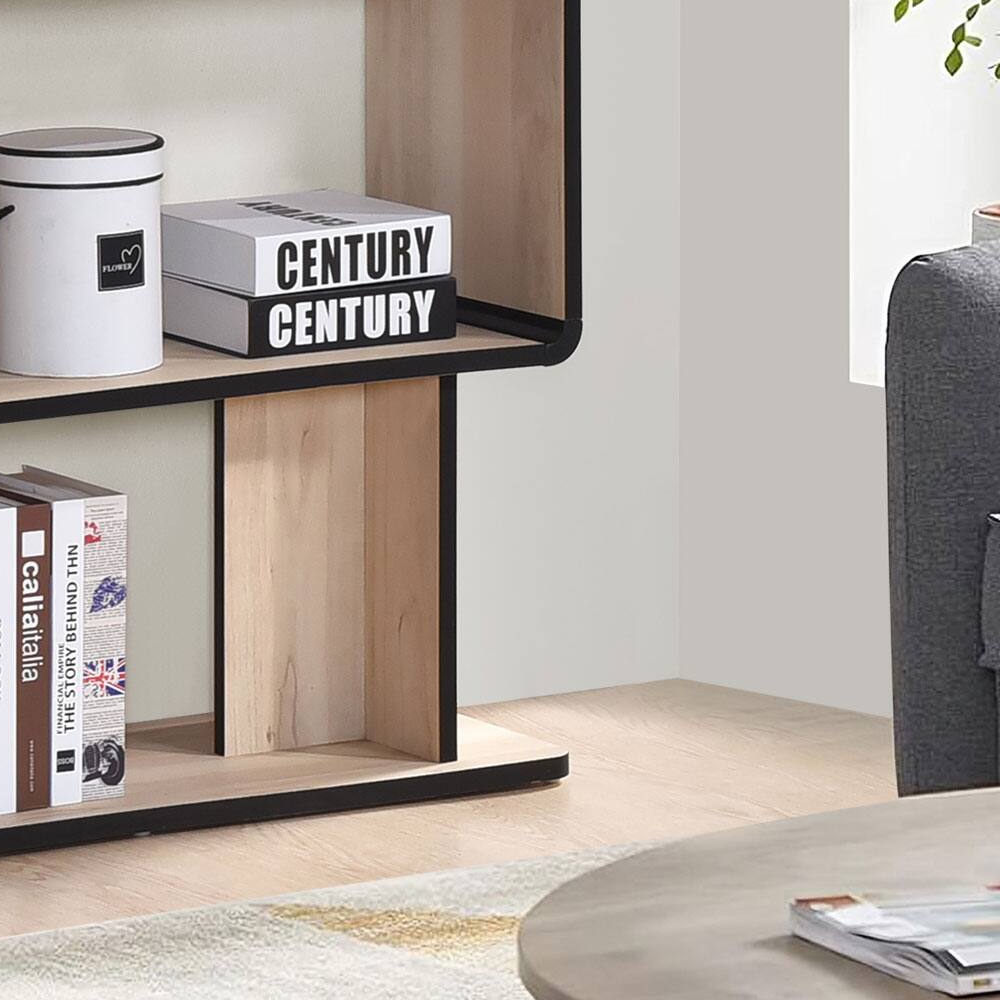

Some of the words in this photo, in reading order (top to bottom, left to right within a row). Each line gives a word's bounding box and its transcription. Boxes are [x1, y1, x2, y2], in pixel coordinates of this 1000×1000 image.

[102, 262, 132, 273] FLOWER
[277, 225, 434, 291] CENTURY
[268, 289, 436, 349] CENTURY
[67, 544, 79, 578] THN
[22, 561, 45, 683] caliaitalia
[66, 582, 78, 642] BEHIND
[65, 648, 77, 698] STORY
[56, 683, 64, 735] FINANCIAL
[64, 702, 76, 735] THE
